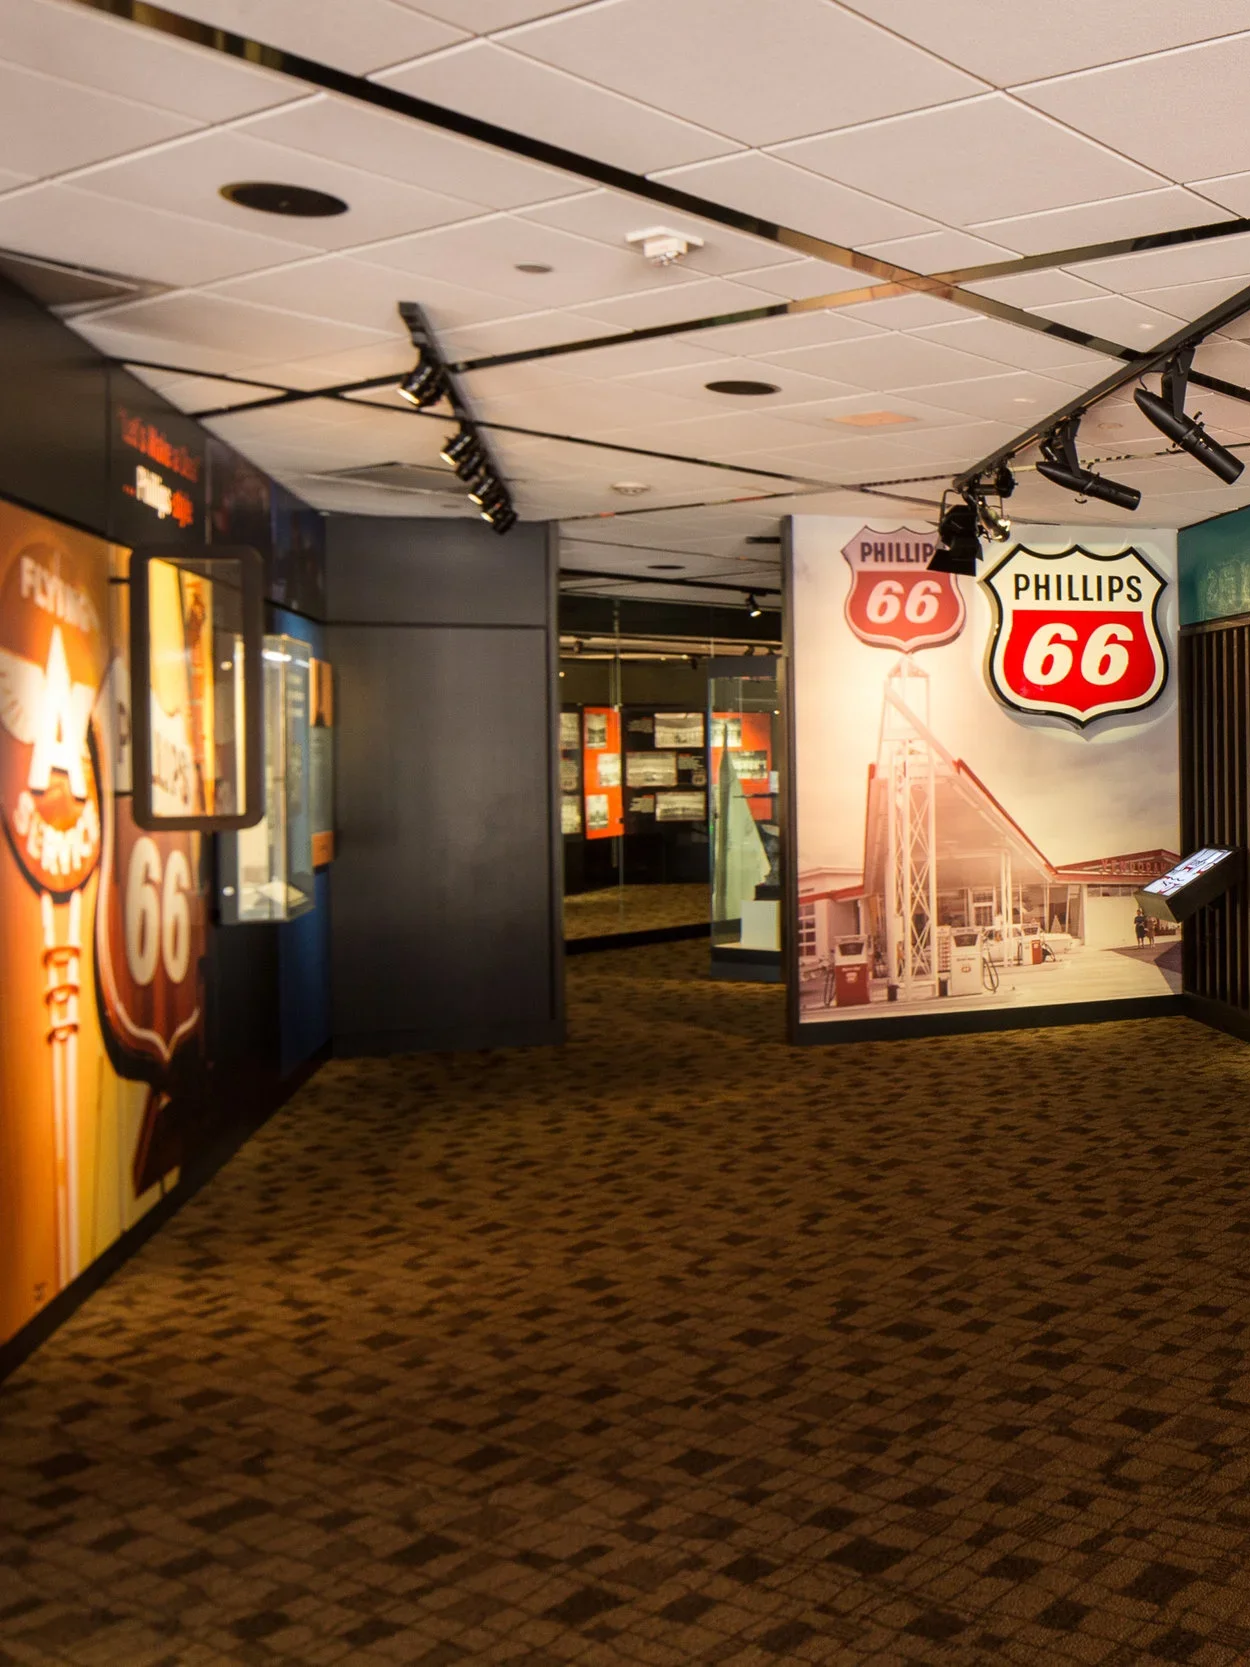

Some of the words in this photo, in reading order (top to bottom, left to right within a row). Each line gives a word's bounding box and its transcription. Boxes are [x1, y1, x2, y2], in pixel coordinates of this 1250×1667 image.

[860, 541, 936, 563] PHILLIP
[866, 579, 943, 625] 66
[1014, 573, 1144, 603] PHILLIPS
[1023, 622, 1134, 686] 66
[126, 836, 193, 986] 66
